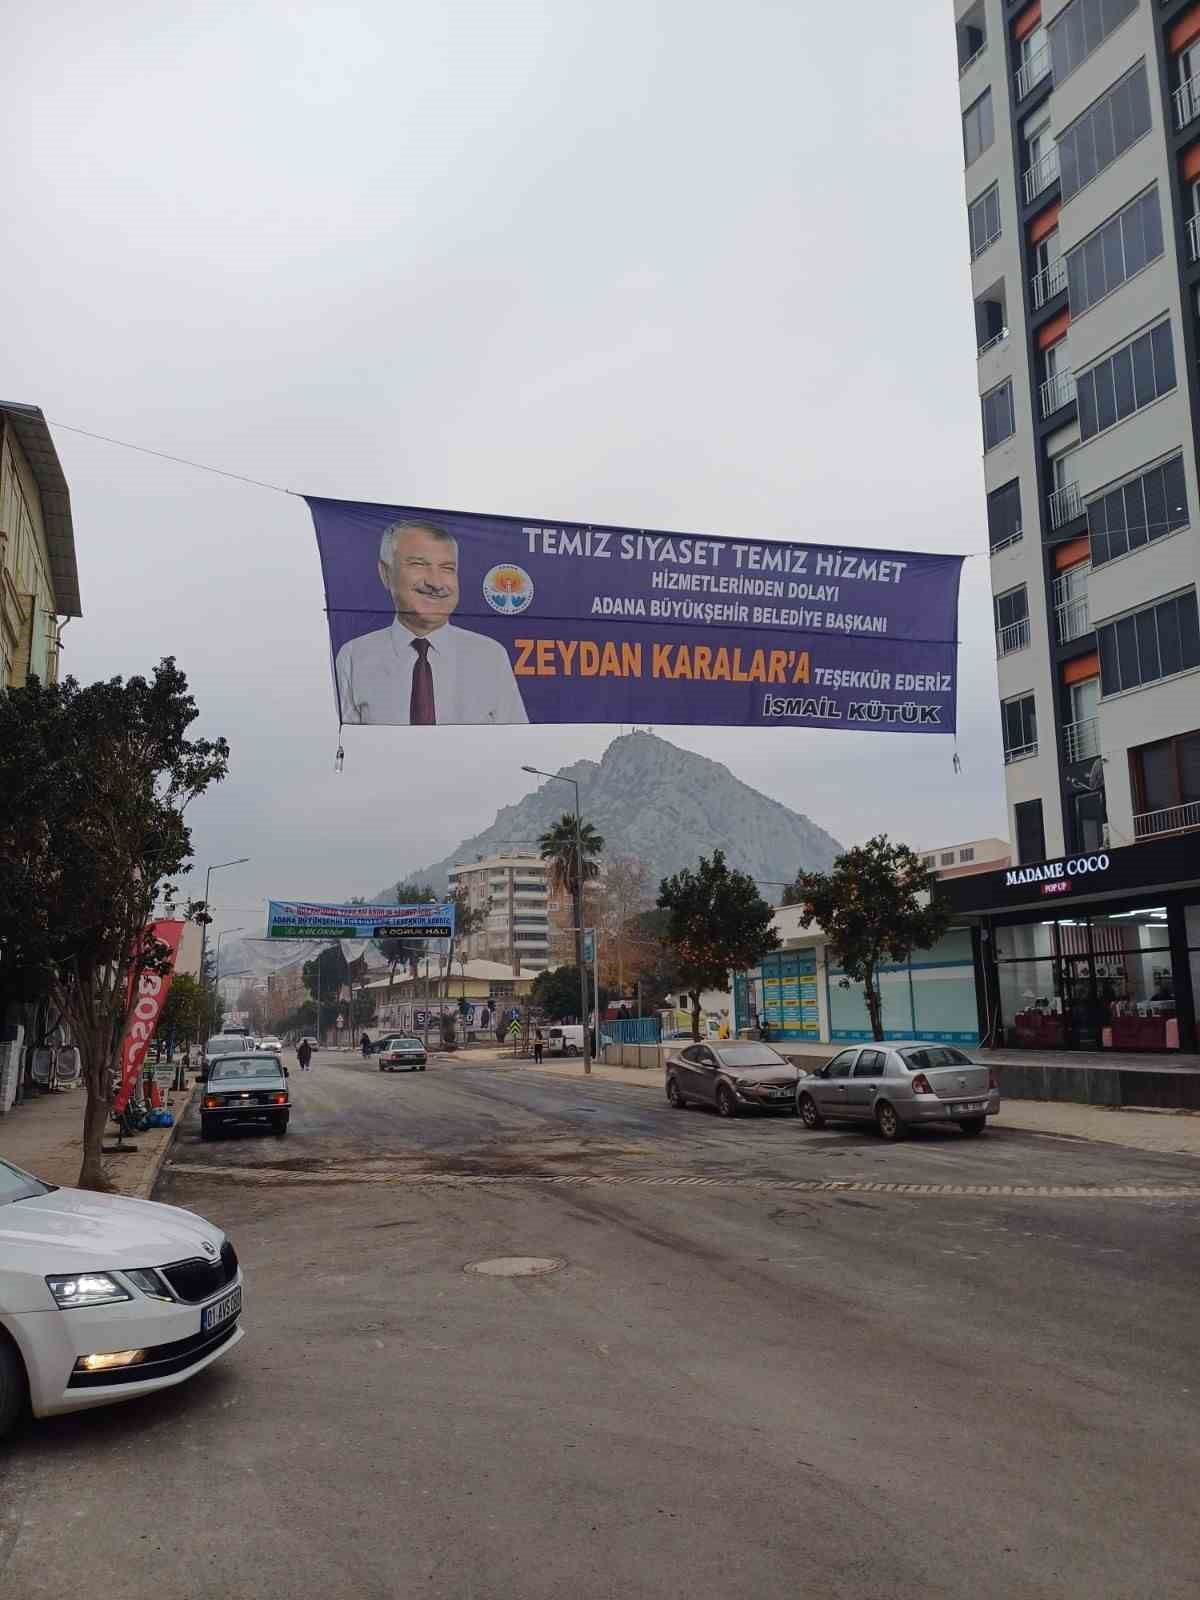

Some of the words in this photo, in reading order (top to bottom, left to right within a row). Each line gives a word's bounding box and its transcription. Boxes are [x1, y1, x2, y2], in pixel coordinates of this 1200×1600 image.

[522, 525, 612, 558] TEMİZ
[620, 529, 726, 566] SİYASET
[732, 544, 809, 574] TEMİZ
[815, 550, 907, 584] HİZMET
[652, 568, 784, 598] HİZMETLERİNDEN
[788, 582, 840, 602] DOLAYI
[591, 596, 646, 616] ADANA
[650, 597, 749, 624] BÜYÜKŞEHİR
[753, 606, 823, 628] BELEDİYE
[826, 612, 888, 634] BAŞKANI
[514, 639, 642, 677] ZEYDAN
[652, 643, 811, 684] KARALAR'A
[814, 667, 891, 691] TEŞEKKÜR
[895, 671, 952, 692] EDERİZ
[763, 693, 842, 718] İSMAİL
[847, 700, 943, 724] KÜTÜK
[1005, 862, 1064, 886] MADAME
[1066, 854, 1110, 876] COCO
[1044, 883, 1058, 893] POP
[1058, 881, 1067, 892] UP
[128, 974, 162, 1085] BOSC
